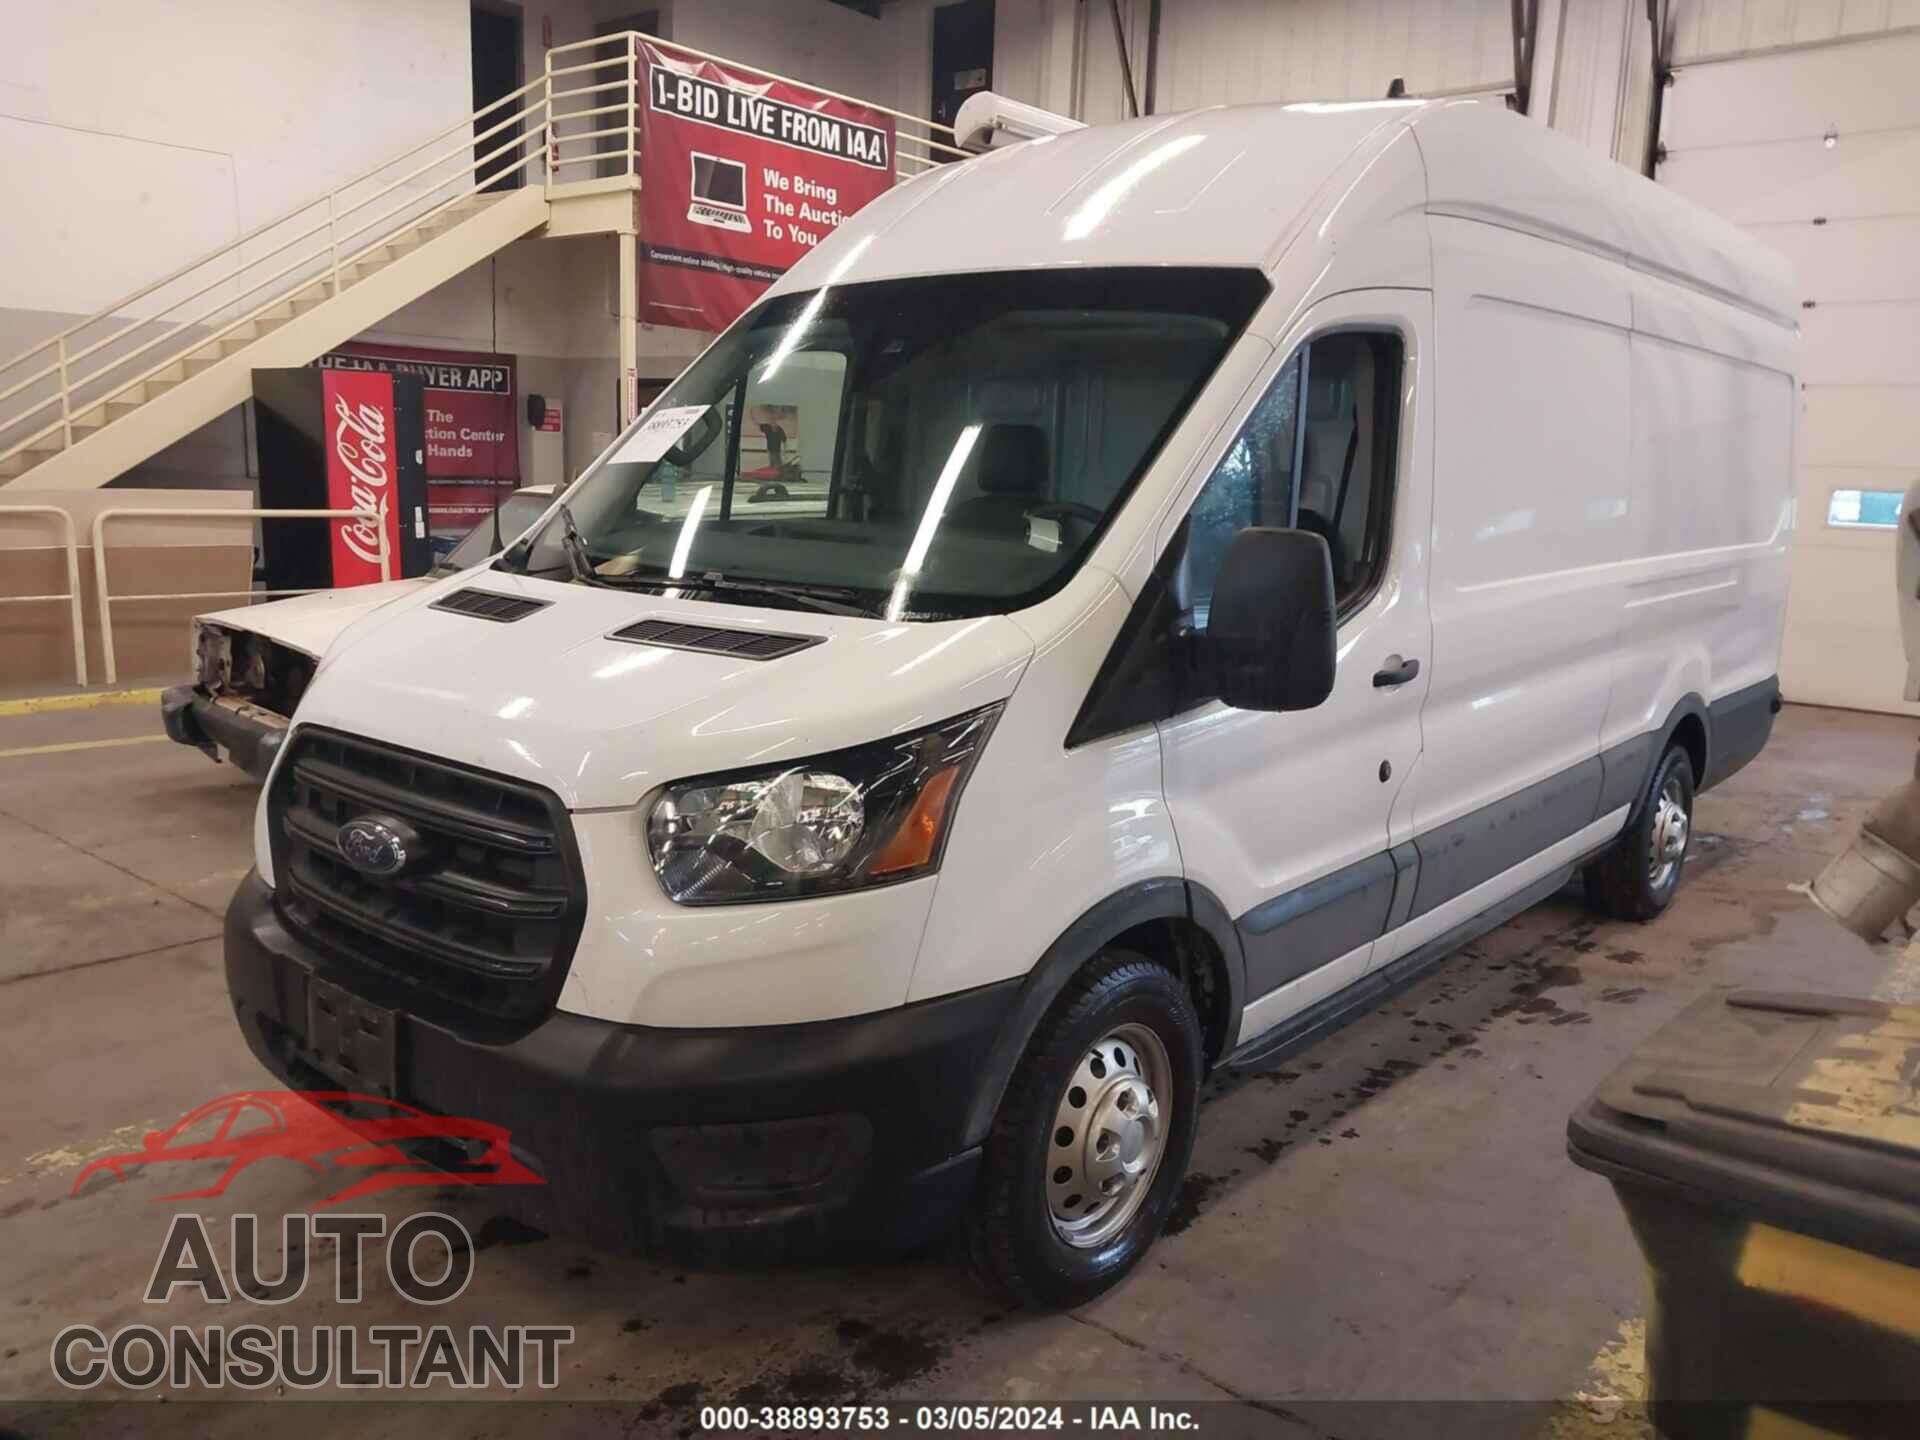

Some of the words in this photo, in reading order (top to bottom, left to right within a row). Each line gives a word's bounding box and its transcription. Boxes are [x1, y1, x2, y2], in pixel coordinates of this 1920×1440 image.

[657, 73, 719, 119] I-BID
[727, 93, 775, 135] LIVE
[781, 111, 840, 151] FROM
[847, 128, 882, 163] IAA
[763, 168, 789, 191] We
[794, 176, 837, 206] Bring
[763, 193, 794, 217] The
[799, 202, 849, 226] Aucti
[763, 219, 783, 240] To
[466, 370, 503, 389] APP
[427, 409, 454, 423] The
[460, 428, 505, 442] Center
[427, 445, 473, 458] Hands
[335, 392, 392, 565] Coca-Cola
